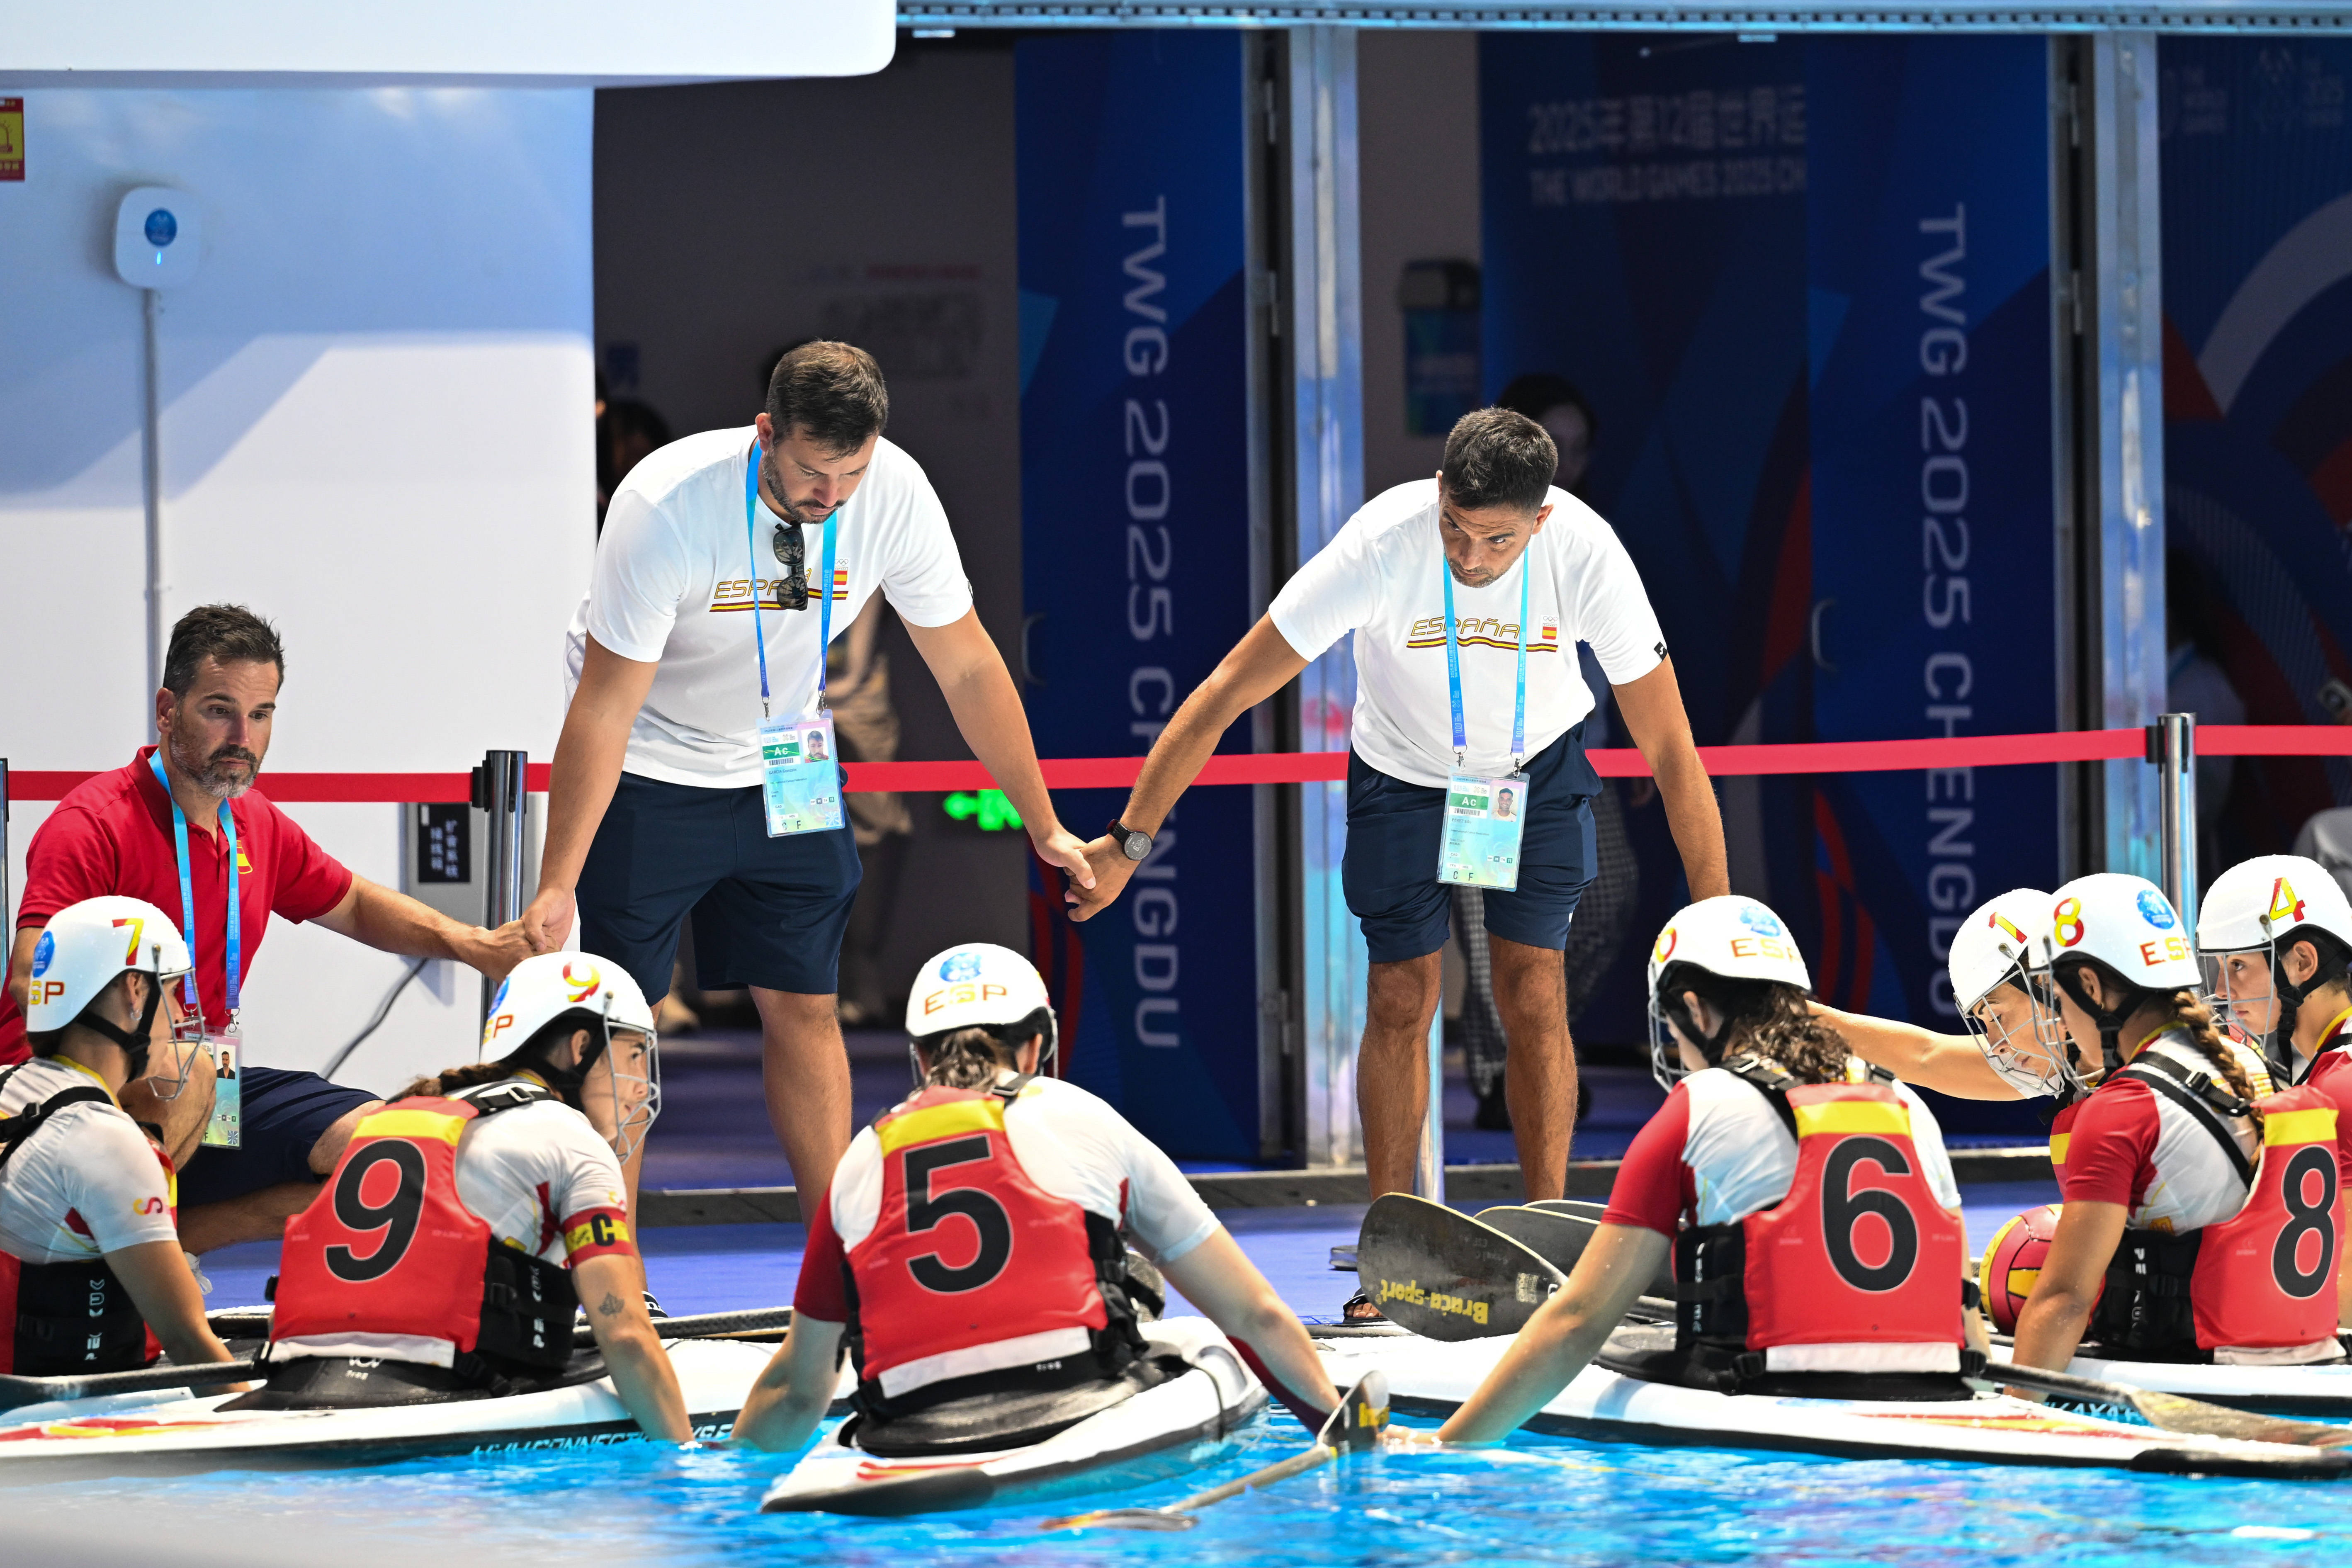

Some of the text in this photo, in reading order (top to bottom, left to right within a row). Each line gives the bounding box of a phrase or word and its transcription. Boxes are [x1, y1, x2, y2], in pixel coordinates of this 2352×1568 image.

[1121, 195, 1168, 377] TWG
[1920, 202, 1966, 375] TWG
[1127, 398, 1172, 640] 2025
[1922, 397, 1970, 628] 2025
[774, 746, 789, 756] Ac
[796, 820, 801, 830] F
[1461, 796, 1477, 807] Ac
[1453, 871, 1474, 881] C F
[2268, 876, 2306, 923] 4
[112, 918, 144, 966] 7
[1988, 912, 2028, 944] 1
[2053, 897, 2085, 948] 8
[562, 961, 600, 1003] 9
[925, 983, 1008, 1015] ESP
[326, 1140, 425, 1281] 9
[590, 1213, 616, 1247] C
[905, 1136, 1011, 1293] 5
[1823, 1137, 1917, 1291] 6
[2273, 1146, 2336, 1298] 8
